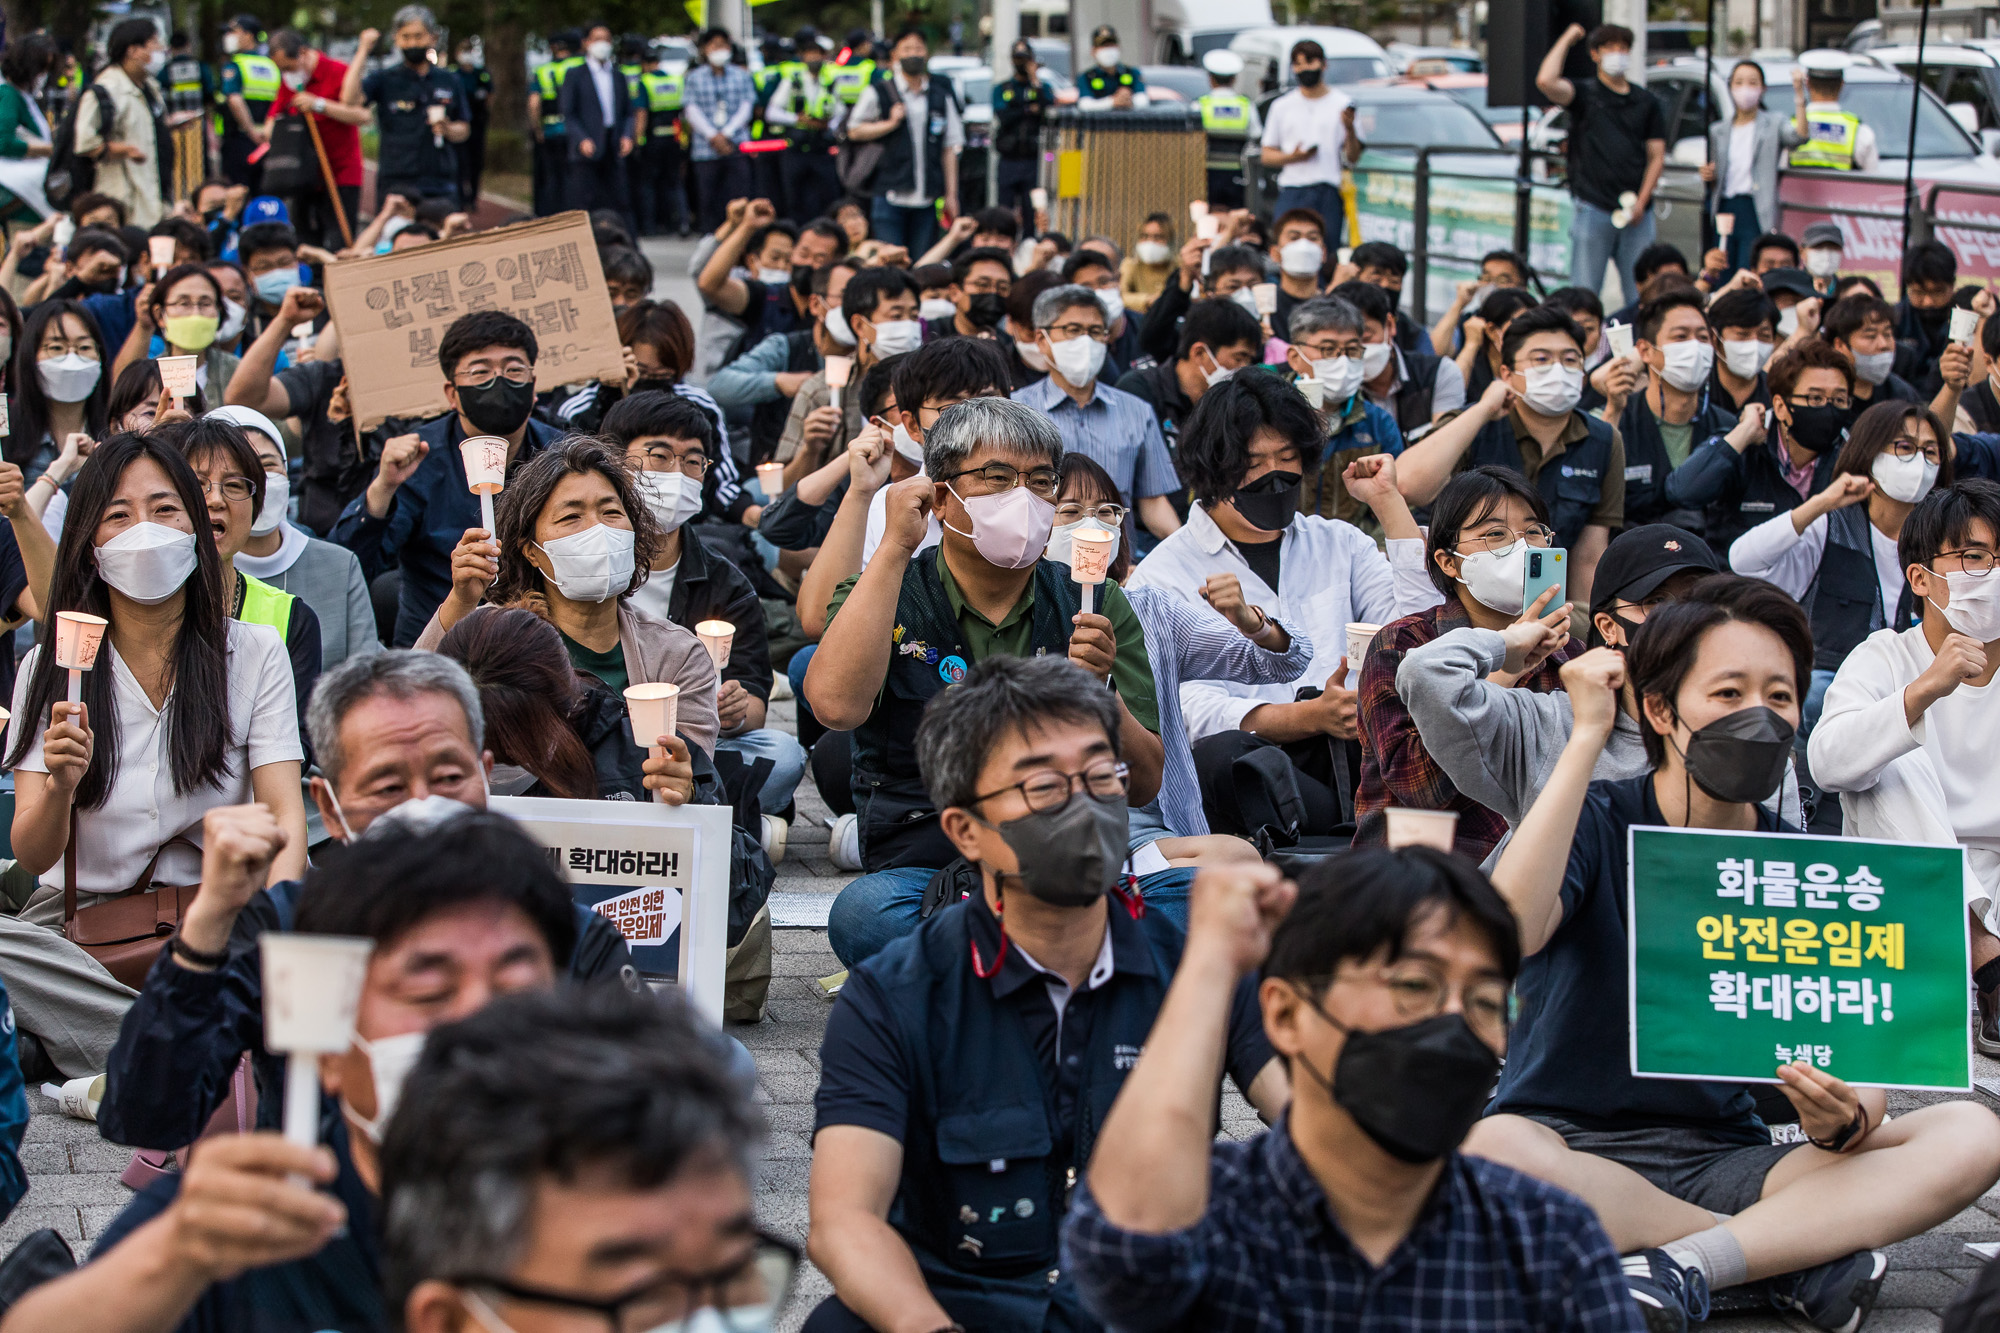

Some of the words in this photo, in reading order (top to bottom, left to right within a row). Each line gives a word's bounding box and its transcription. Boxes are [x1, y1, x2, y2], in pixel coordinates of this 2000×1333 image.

[365, 241, 589, 331] 안전운임제
[604, 792, 622, 801] THE
[568, 847, 679, 877] 확대하라!
[618, 895, 641, 917] 안전
[642, 889, 665, 913] 위한
[1716, 857, 1885, 912] 화물운송
[1696, 914, 1905, 971] 안전운임제
[1708, 970, 1895, 1026] 확대하라!
[1774, 1042, 1834, 1067] 녹색당
